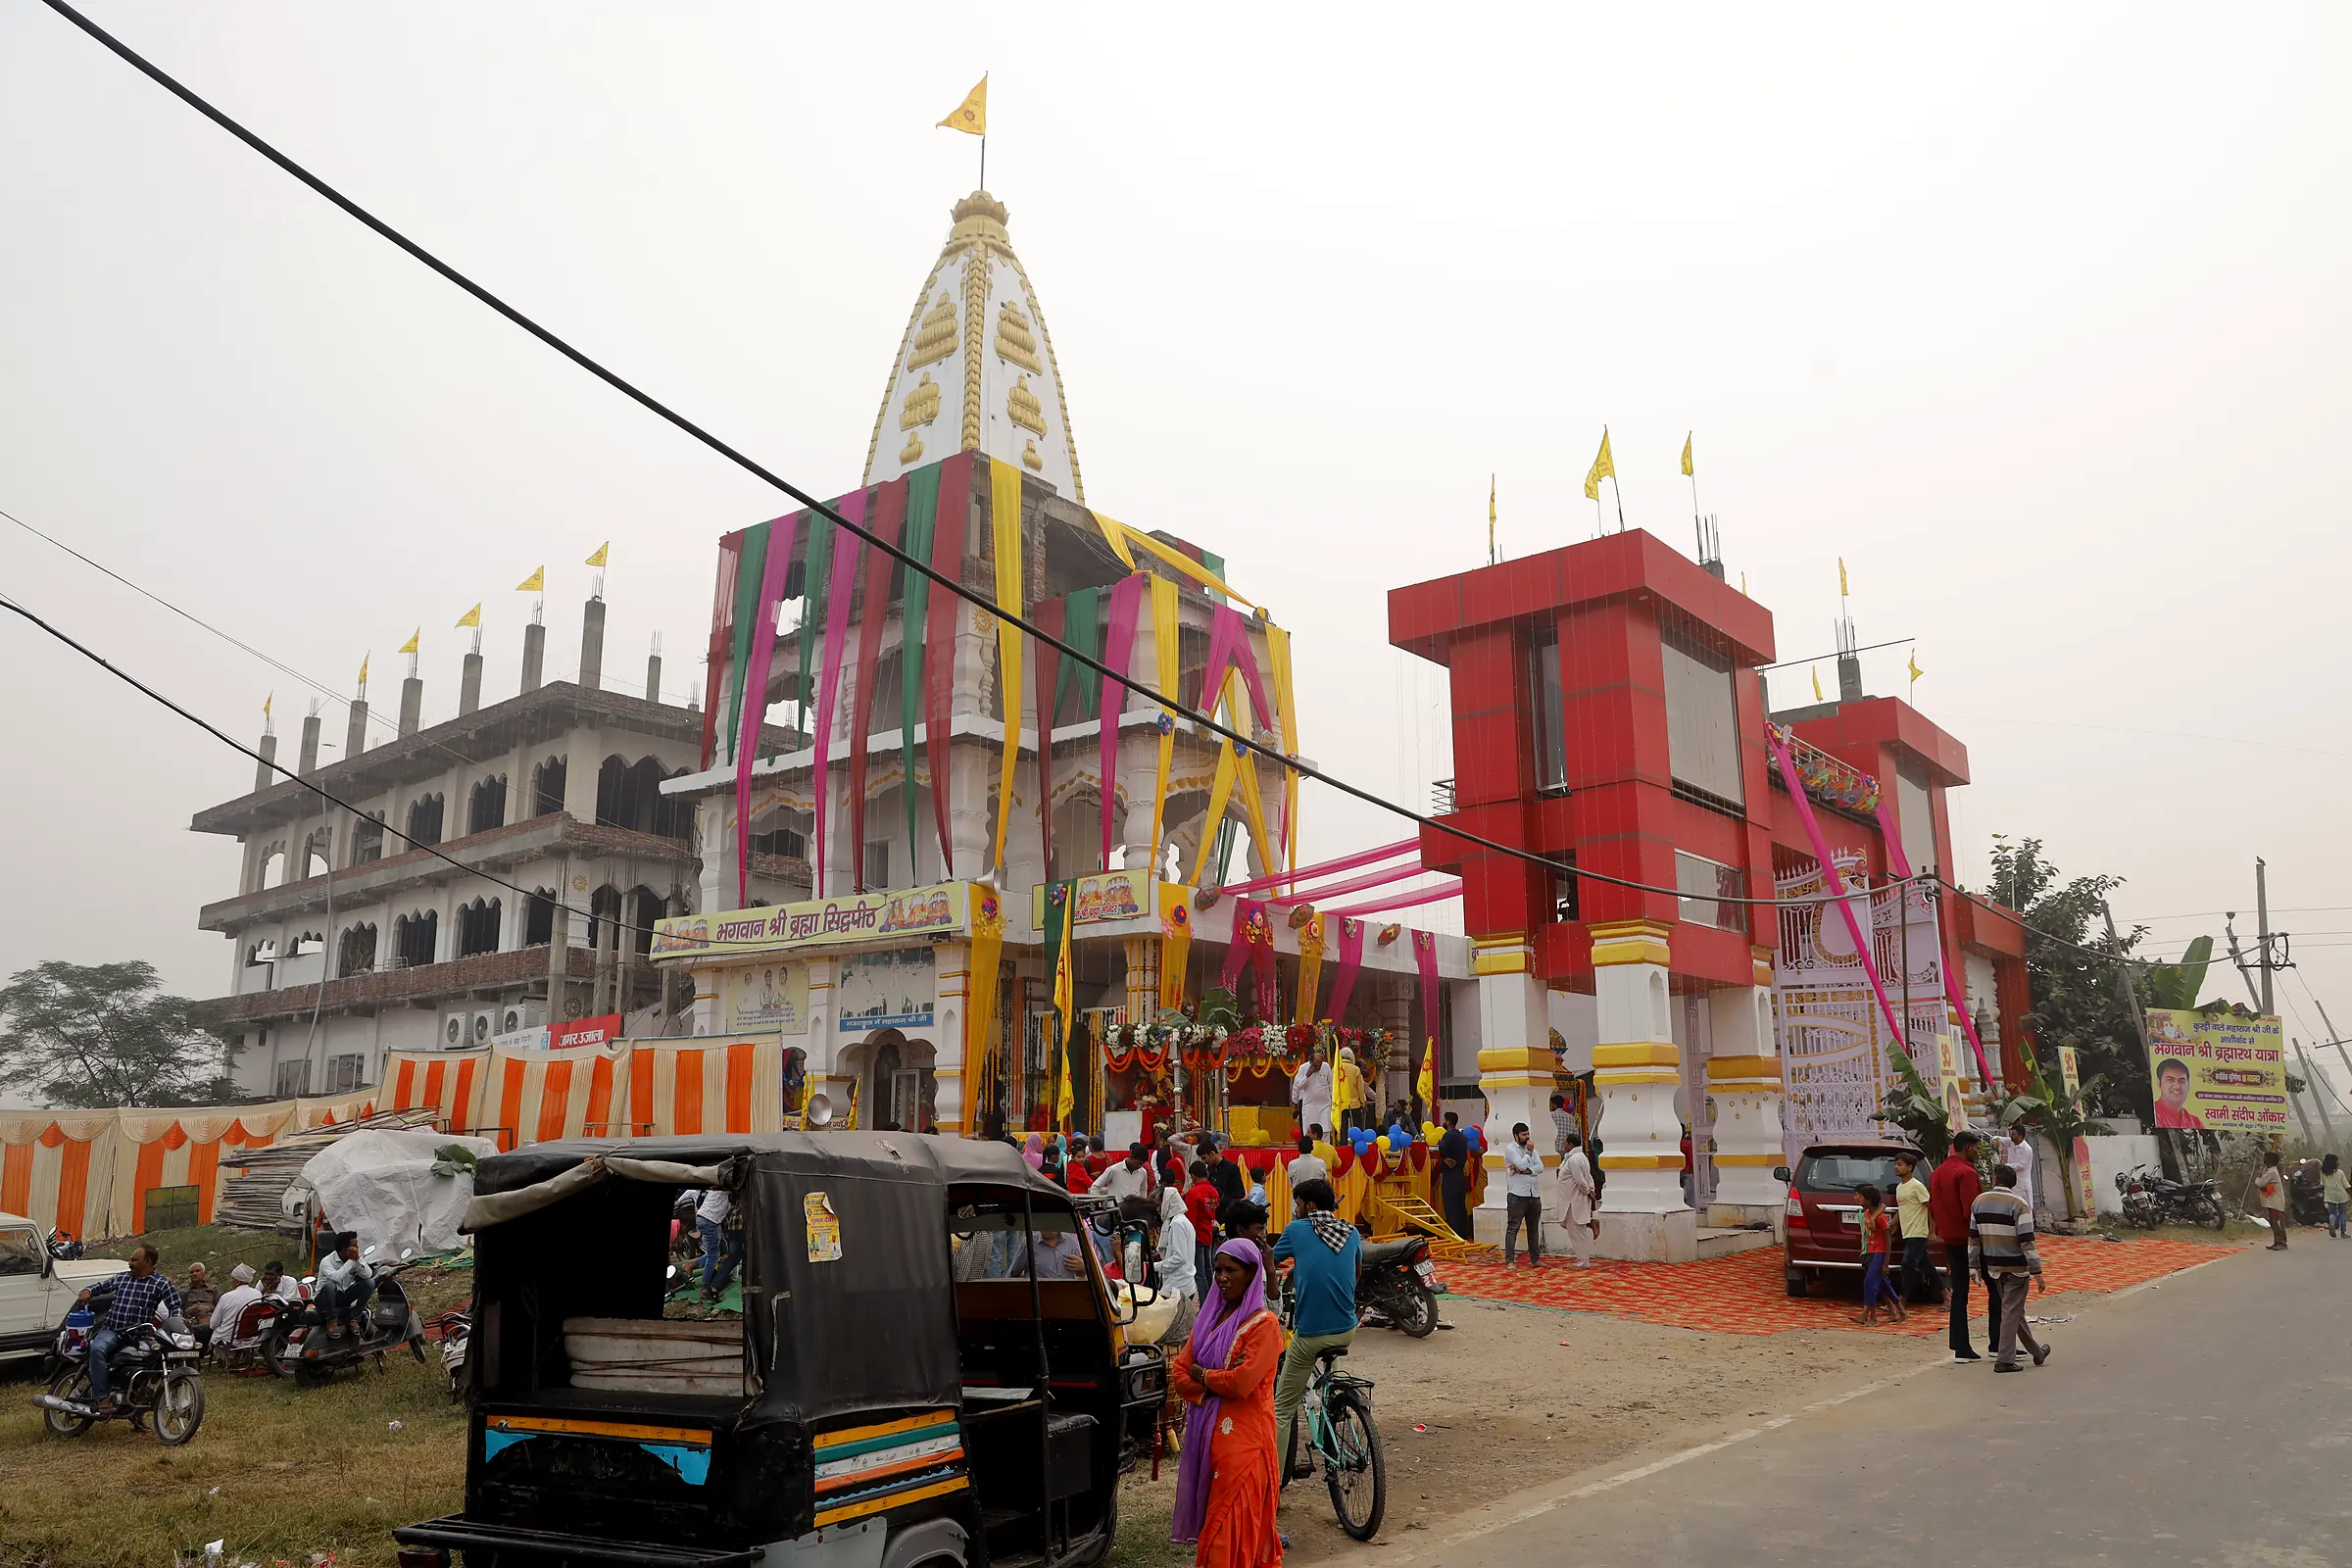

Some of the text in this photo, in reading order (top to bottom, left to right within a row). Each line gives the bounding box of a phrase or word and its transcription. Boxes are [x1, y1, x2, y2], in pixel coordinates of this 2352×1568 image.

[716, 918, 766, 942] भगवान
[769, 908, 787, 937] श्री
[790, 912, 820, 939] ब्रह्मा
[559, 1029, 604, 1047] अमर उजाला
[2227, 1025, 2251, 1034] महाराज
[2262, 1025, 2272, 1035] जी
[2154, 1043, 2195, 1057] भगवान
[2198, 1040, 2212, 1058] श्री
[2254, 1049, 2279, 1062] यात्रा
[2204, 1105, 2230, 1120] स्वामी
[2231, 1106, 2255, 1122] संदीप
